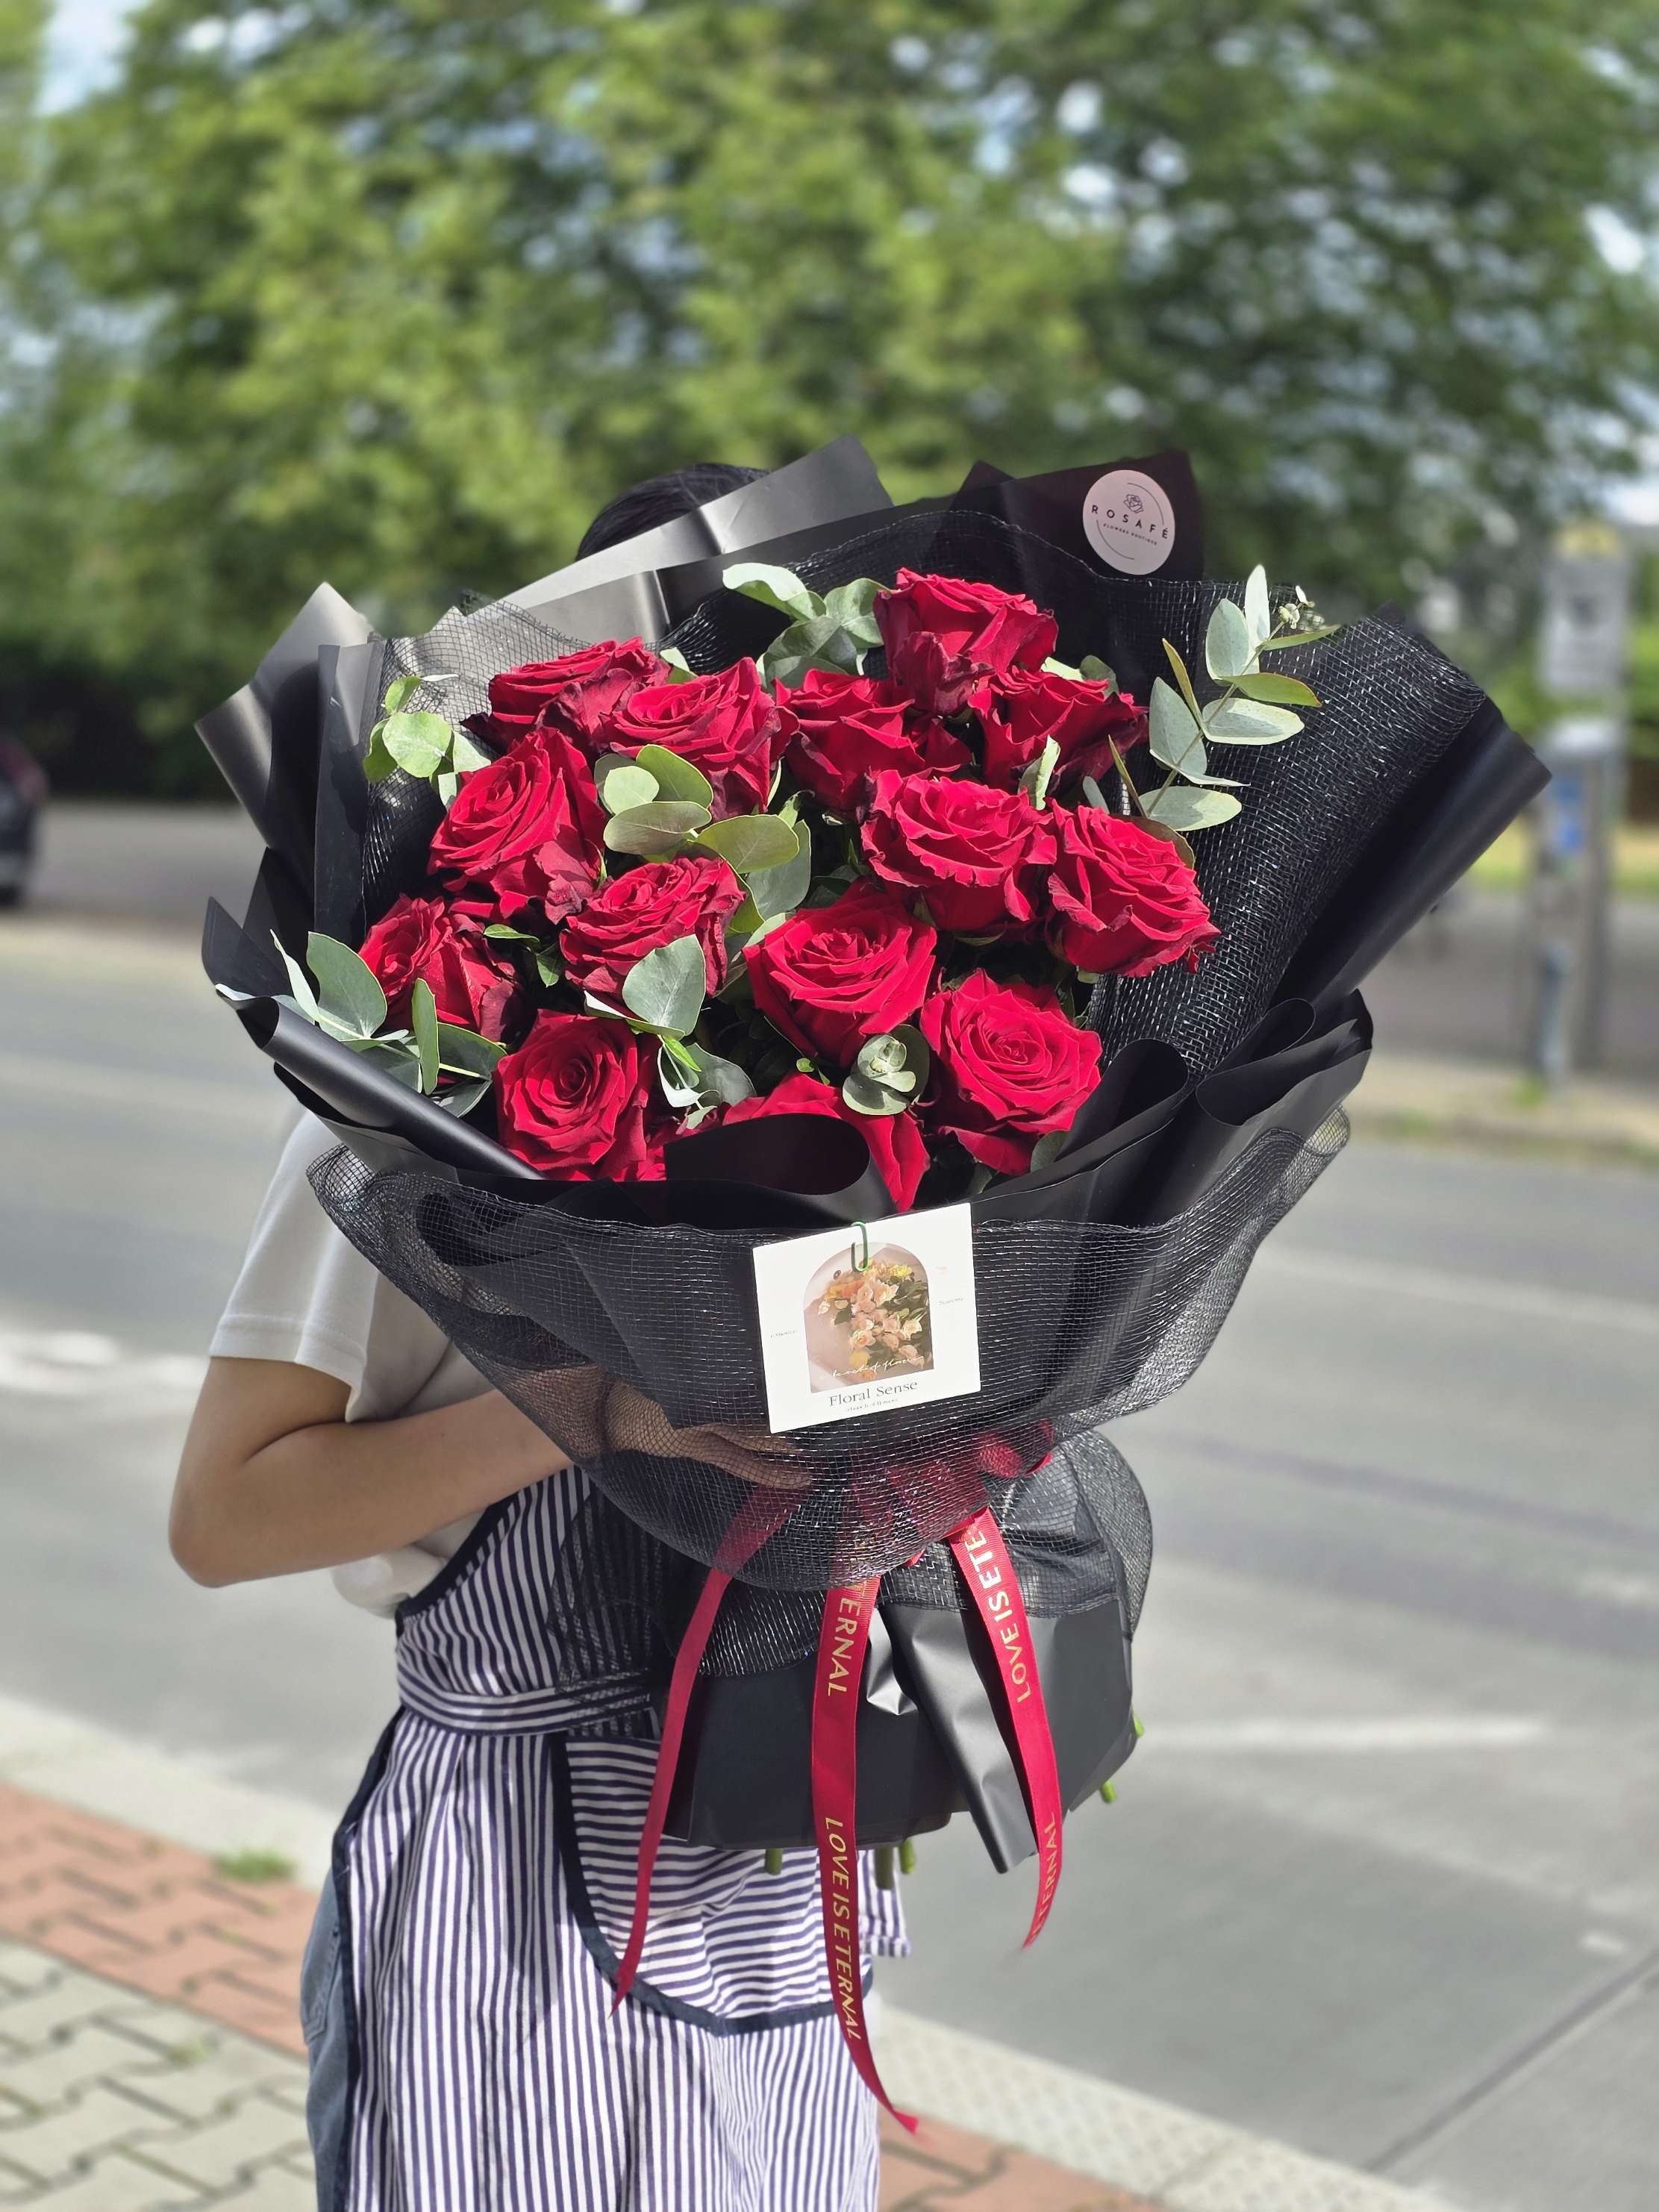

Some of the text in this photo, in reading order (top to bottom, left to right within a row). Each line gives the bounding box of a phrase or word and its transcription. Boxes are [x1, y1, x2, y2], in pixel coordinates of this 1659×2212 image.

[1091, 504, 1169, 540] ROSAFÉ
[829, 1388, 871, 1407] Floral
[876, 1381, 918, 1397] Sense
[988, 1590, 1013, 1622] IS
[1000, 1623, 1031, 1702] LOVE
[825, 1817, 862, 2040] LOVE IS ETERNAL
